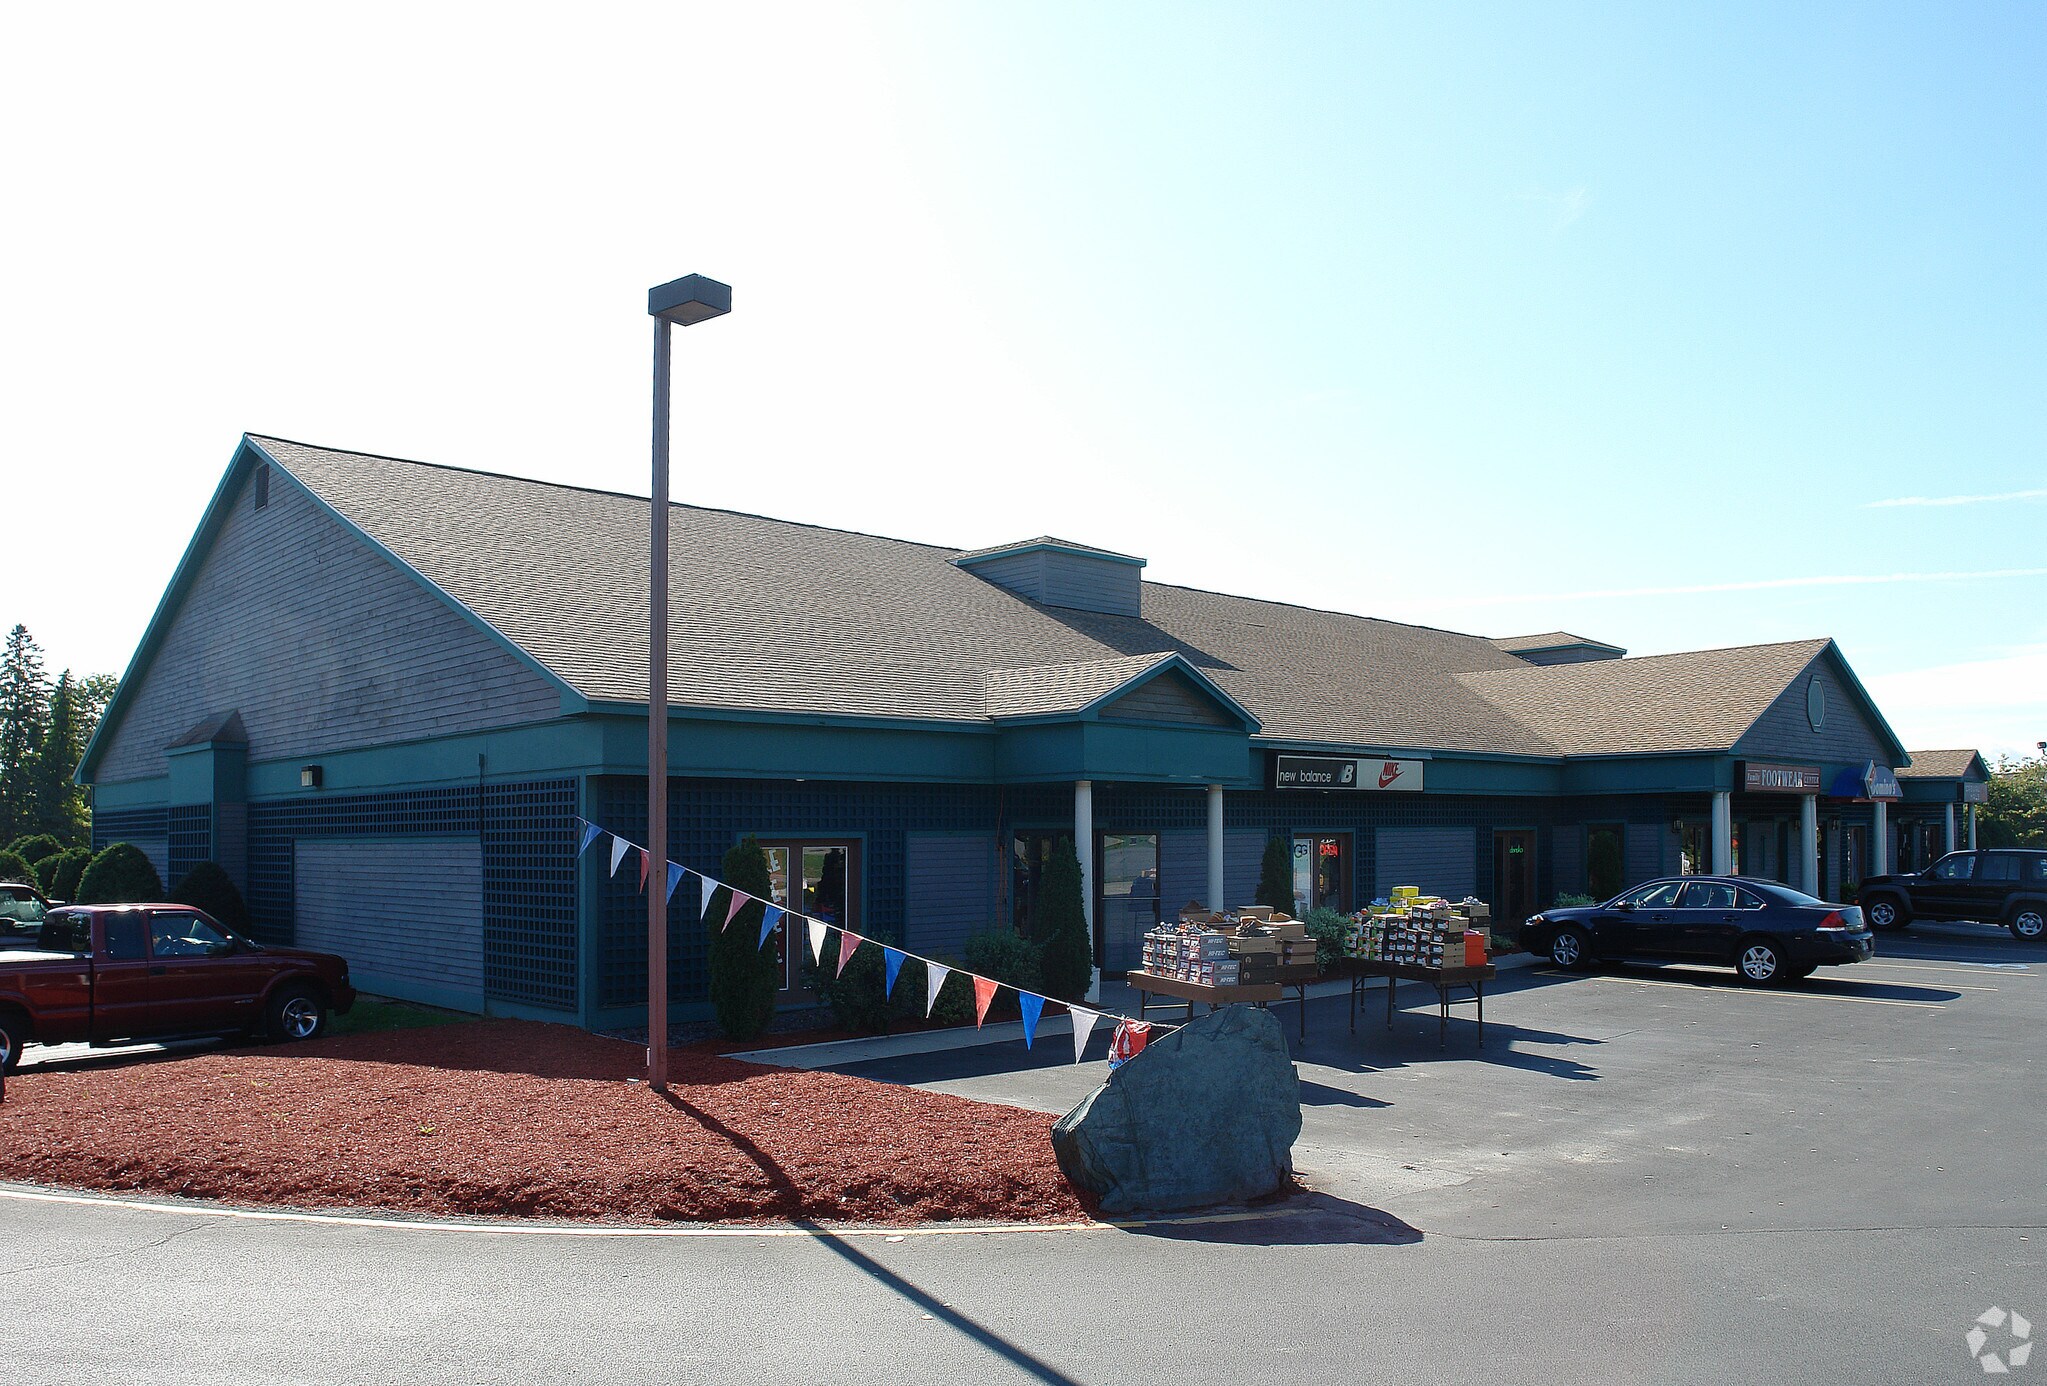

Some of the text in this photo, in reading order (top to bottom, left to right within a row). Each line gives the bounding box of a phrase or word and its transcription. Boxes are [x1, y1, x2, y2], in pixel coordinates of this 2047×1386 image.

[1280, 769, 1331, 783] new balance
[1383, 762, 1399, 776] NIKE
[1761, 769, 1803, 788] FOOTWEAR
